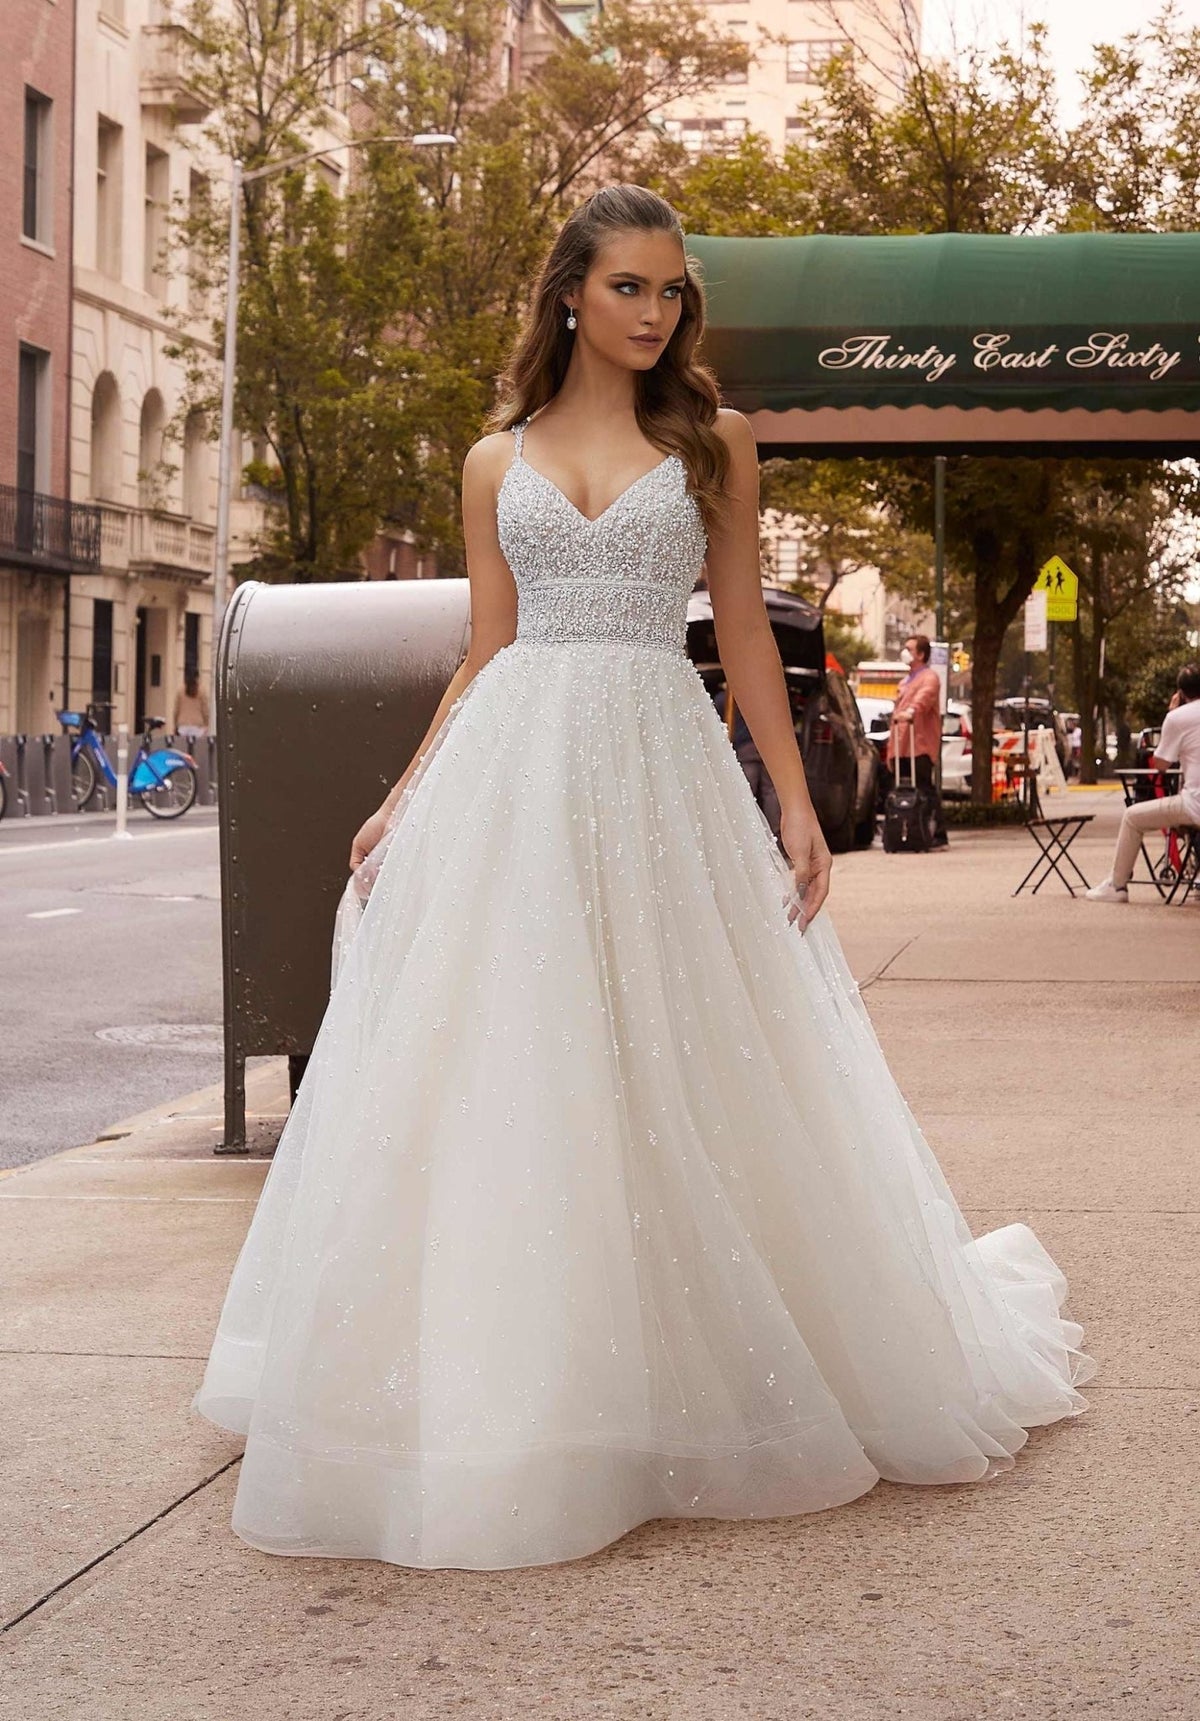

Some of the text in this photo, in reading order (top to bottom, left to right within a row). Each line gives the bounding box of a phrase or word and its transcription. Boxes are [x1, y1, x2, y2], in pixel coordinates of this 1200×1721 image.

[818, 335, 957, 382] Thirty
[973, 333, 1059, 371] East
[1066, 332, 1181, 380] Sixty
